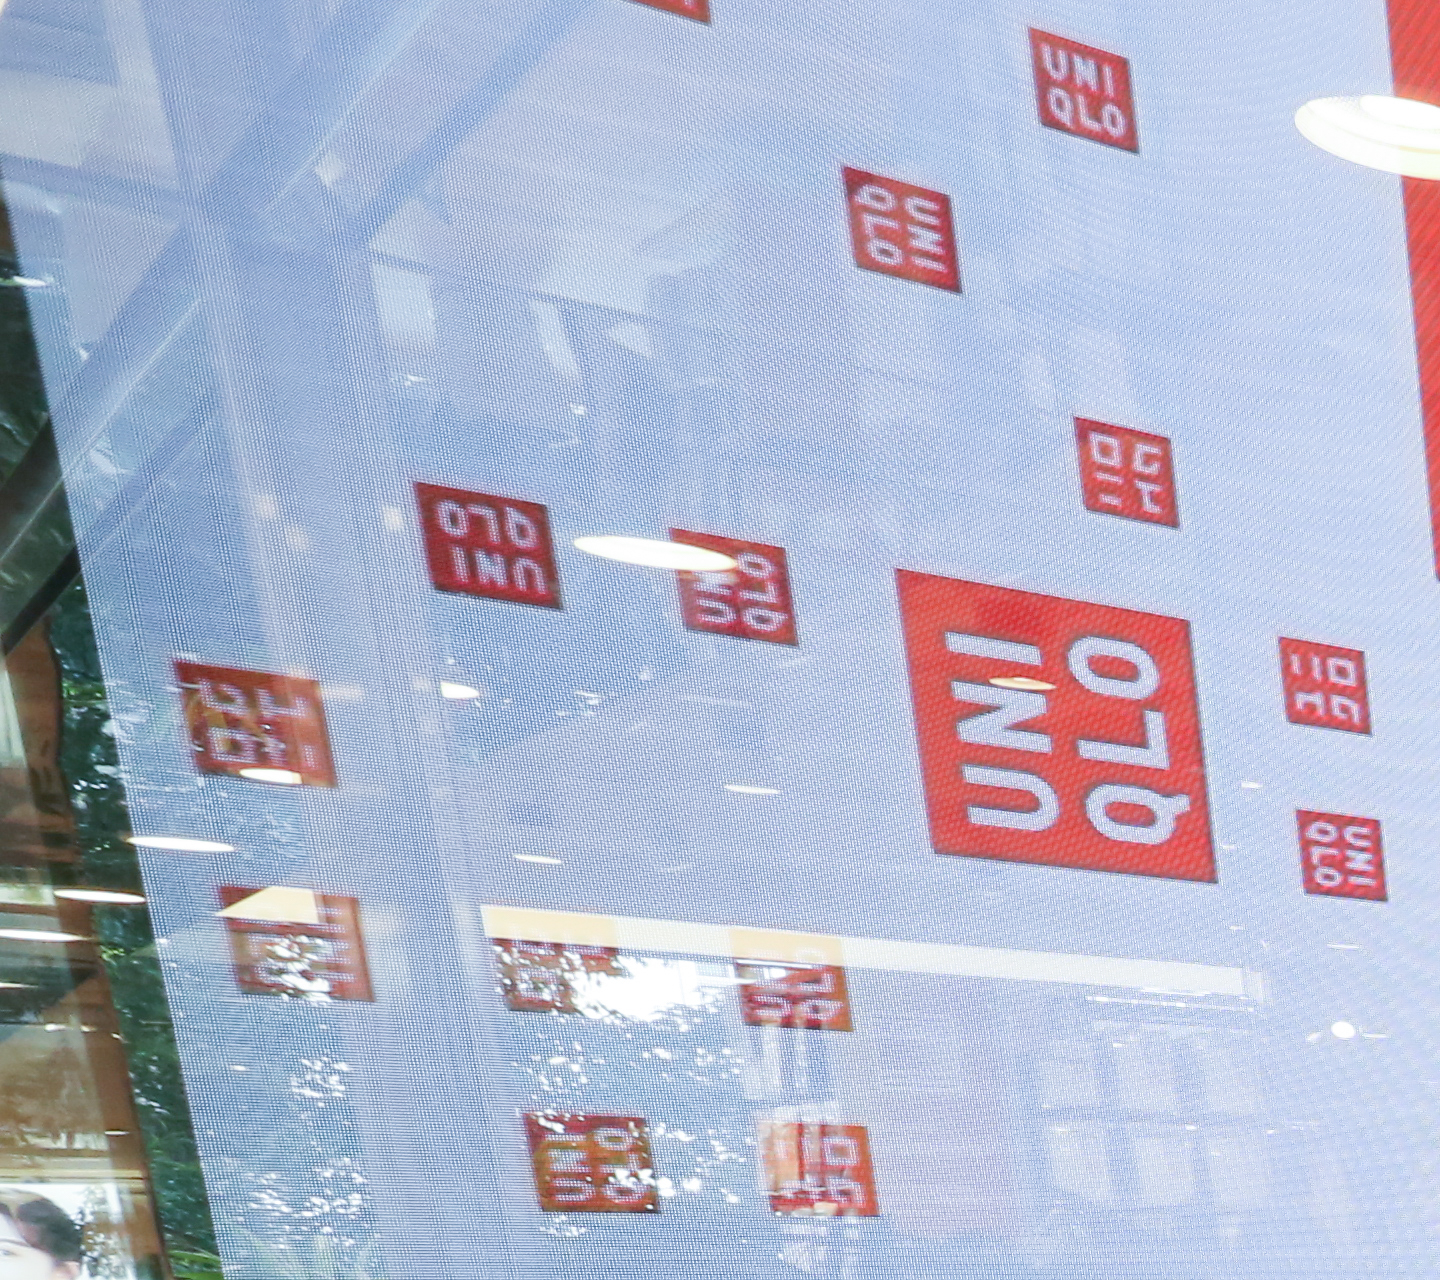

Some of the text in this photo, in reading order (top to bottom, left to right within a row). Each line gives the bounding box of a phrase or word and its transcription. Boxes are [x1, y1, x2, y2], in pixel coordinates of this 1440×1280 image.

[1042, 43, 1113, 95] UNI
[1048, 83, 1123, 131] QLO
[854, 185, 903, 263] QLO
[903, 198, 943, 268] UNI
[943, 630, 1063, 830] UNI
[1068, 633, 1193, 843] QLO
[1303, 821, 1340, 883] QLO
[1341, 825, 1373, 882] UNI
